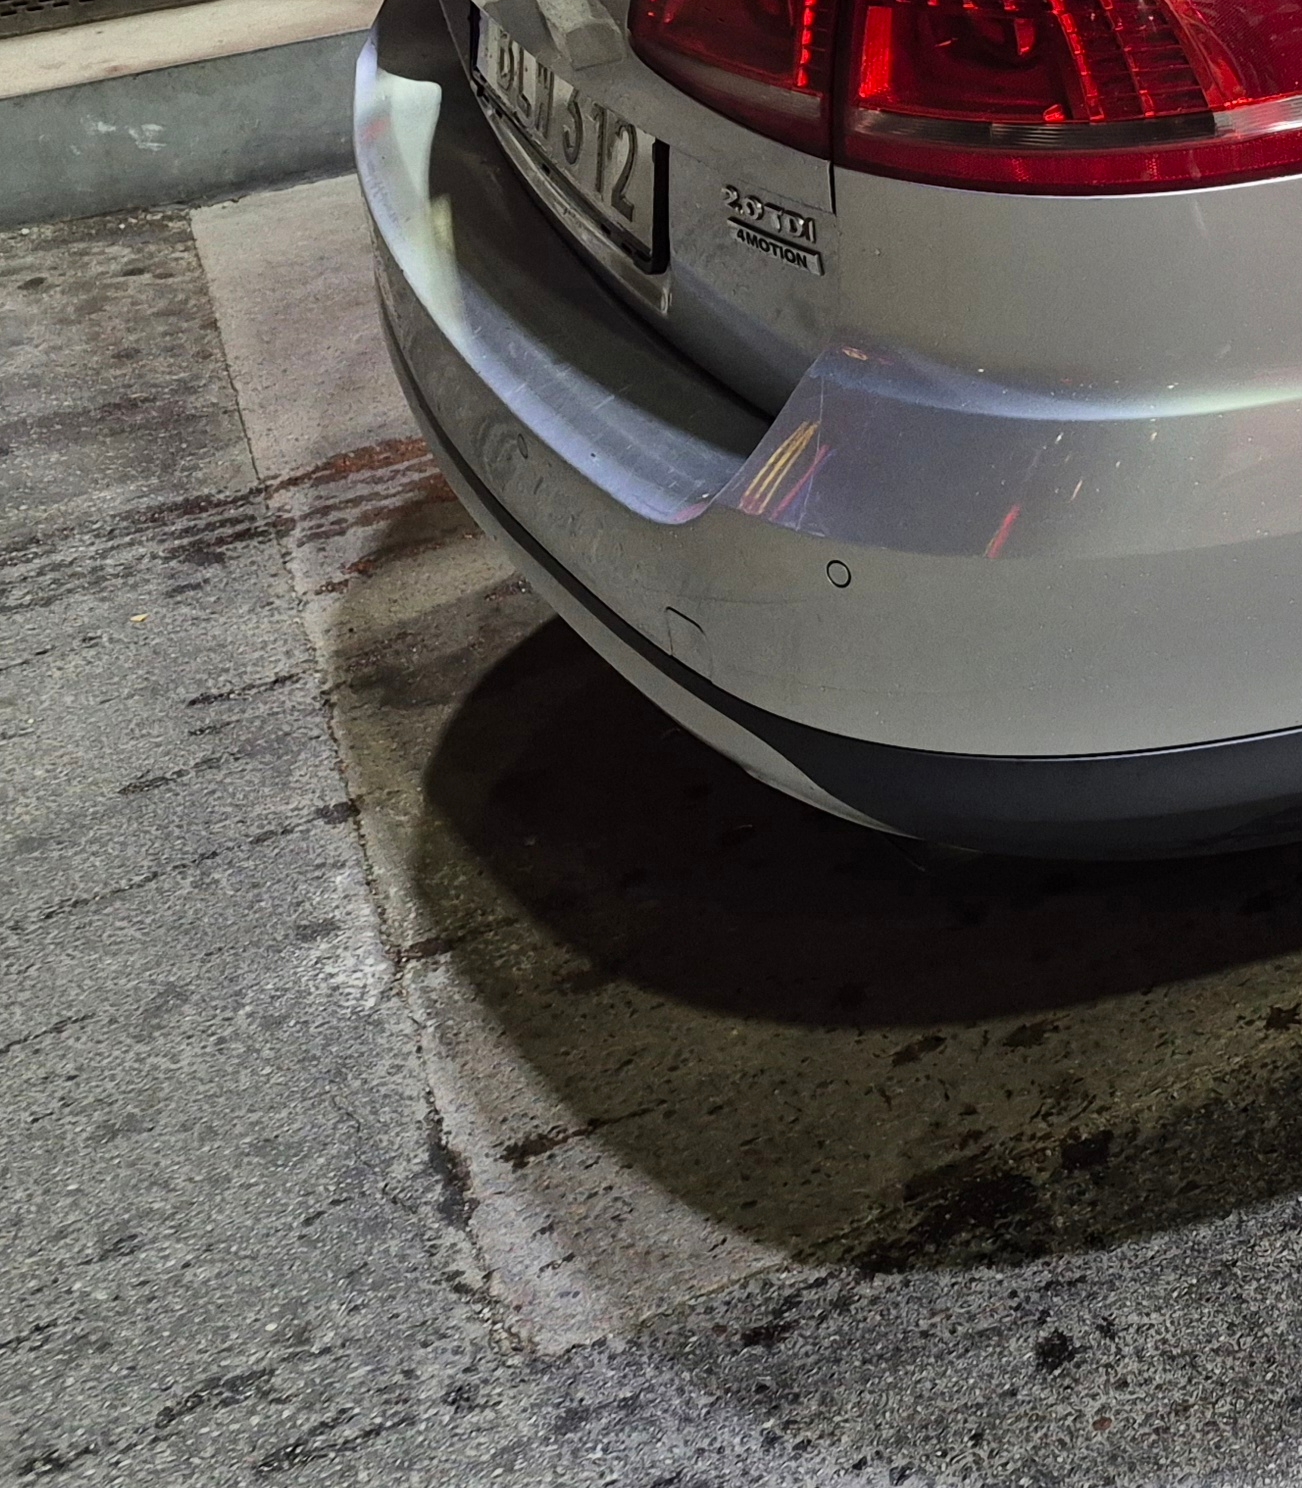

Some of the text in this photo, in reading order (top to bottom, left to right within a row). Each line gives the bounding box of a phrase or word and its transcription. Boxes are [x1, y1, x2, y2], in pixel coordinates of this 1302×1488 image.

[721, 184, 817, 244] 2.0 TDI
[736, 228, 808, 269] 4MOTION
